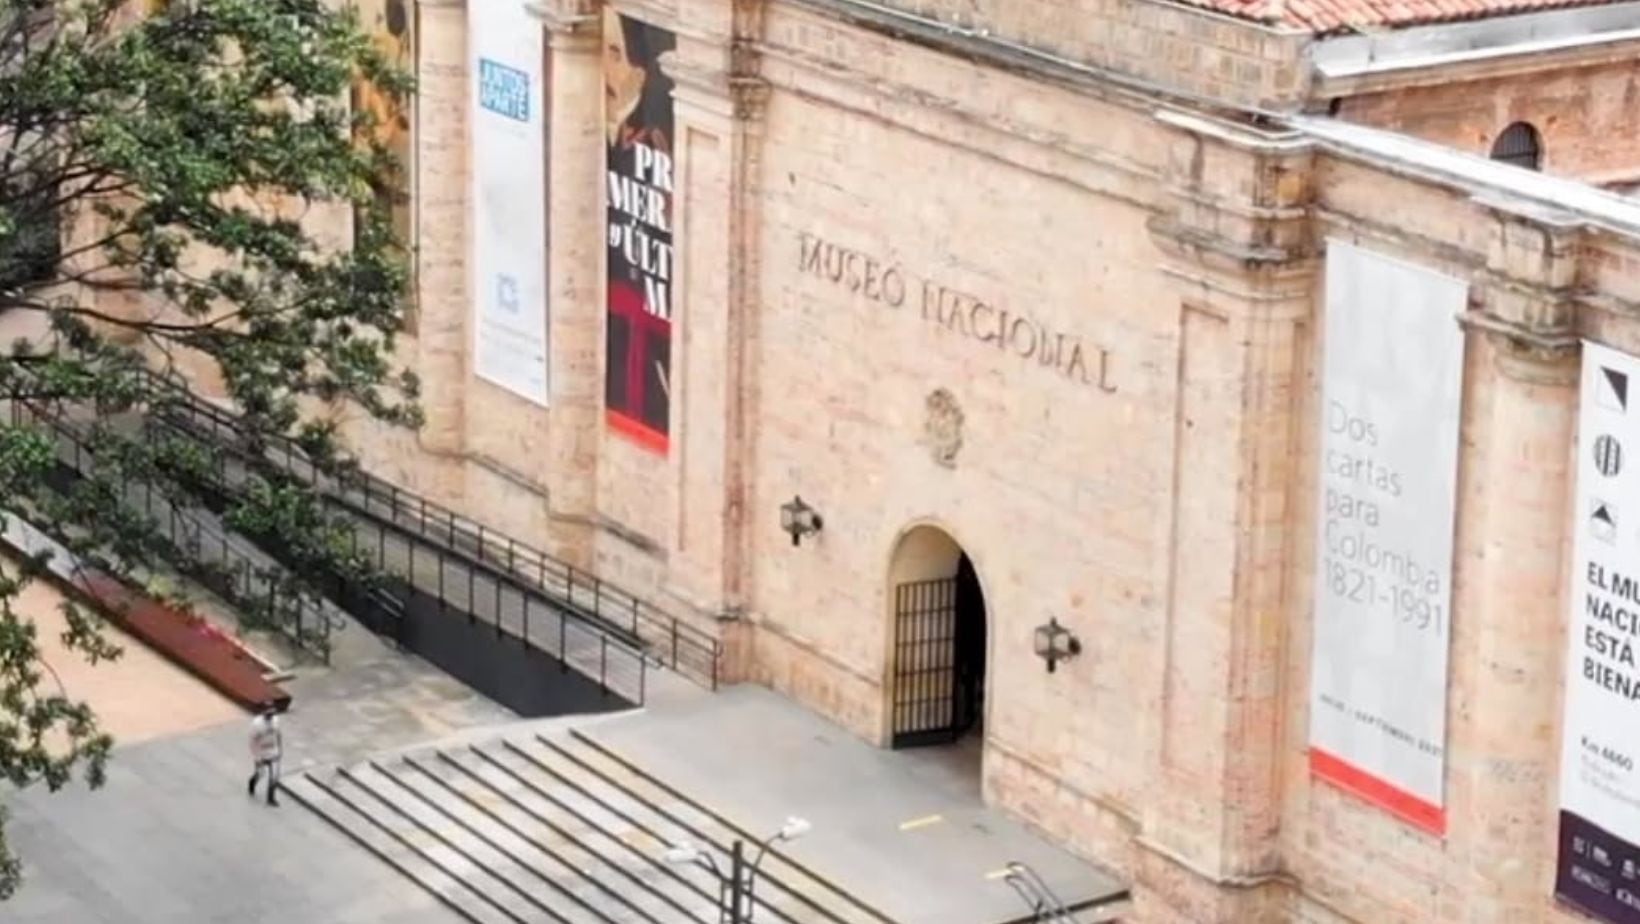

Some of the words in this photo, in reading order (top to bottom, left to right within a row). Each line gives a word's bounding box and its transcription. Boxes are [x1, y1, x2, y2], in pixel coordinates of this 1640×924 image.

[634, 142, 672, 193] PR
[921, 280, 1118, 394] NACIONAL
[1329, 400, 1379, 447] Dos
[1327, 449, 1402, 497] cartas
[1326, 487, 1380, 527] para
[1325, 518, 1440, 595] Colomba
[1587, 561, 1607, 590] EL
[1324, 557, 1443, 637] 1821-1991
[1586, 593, 1640, 637] NACI
[1585, 624, 1635, 668] ESTÁ
